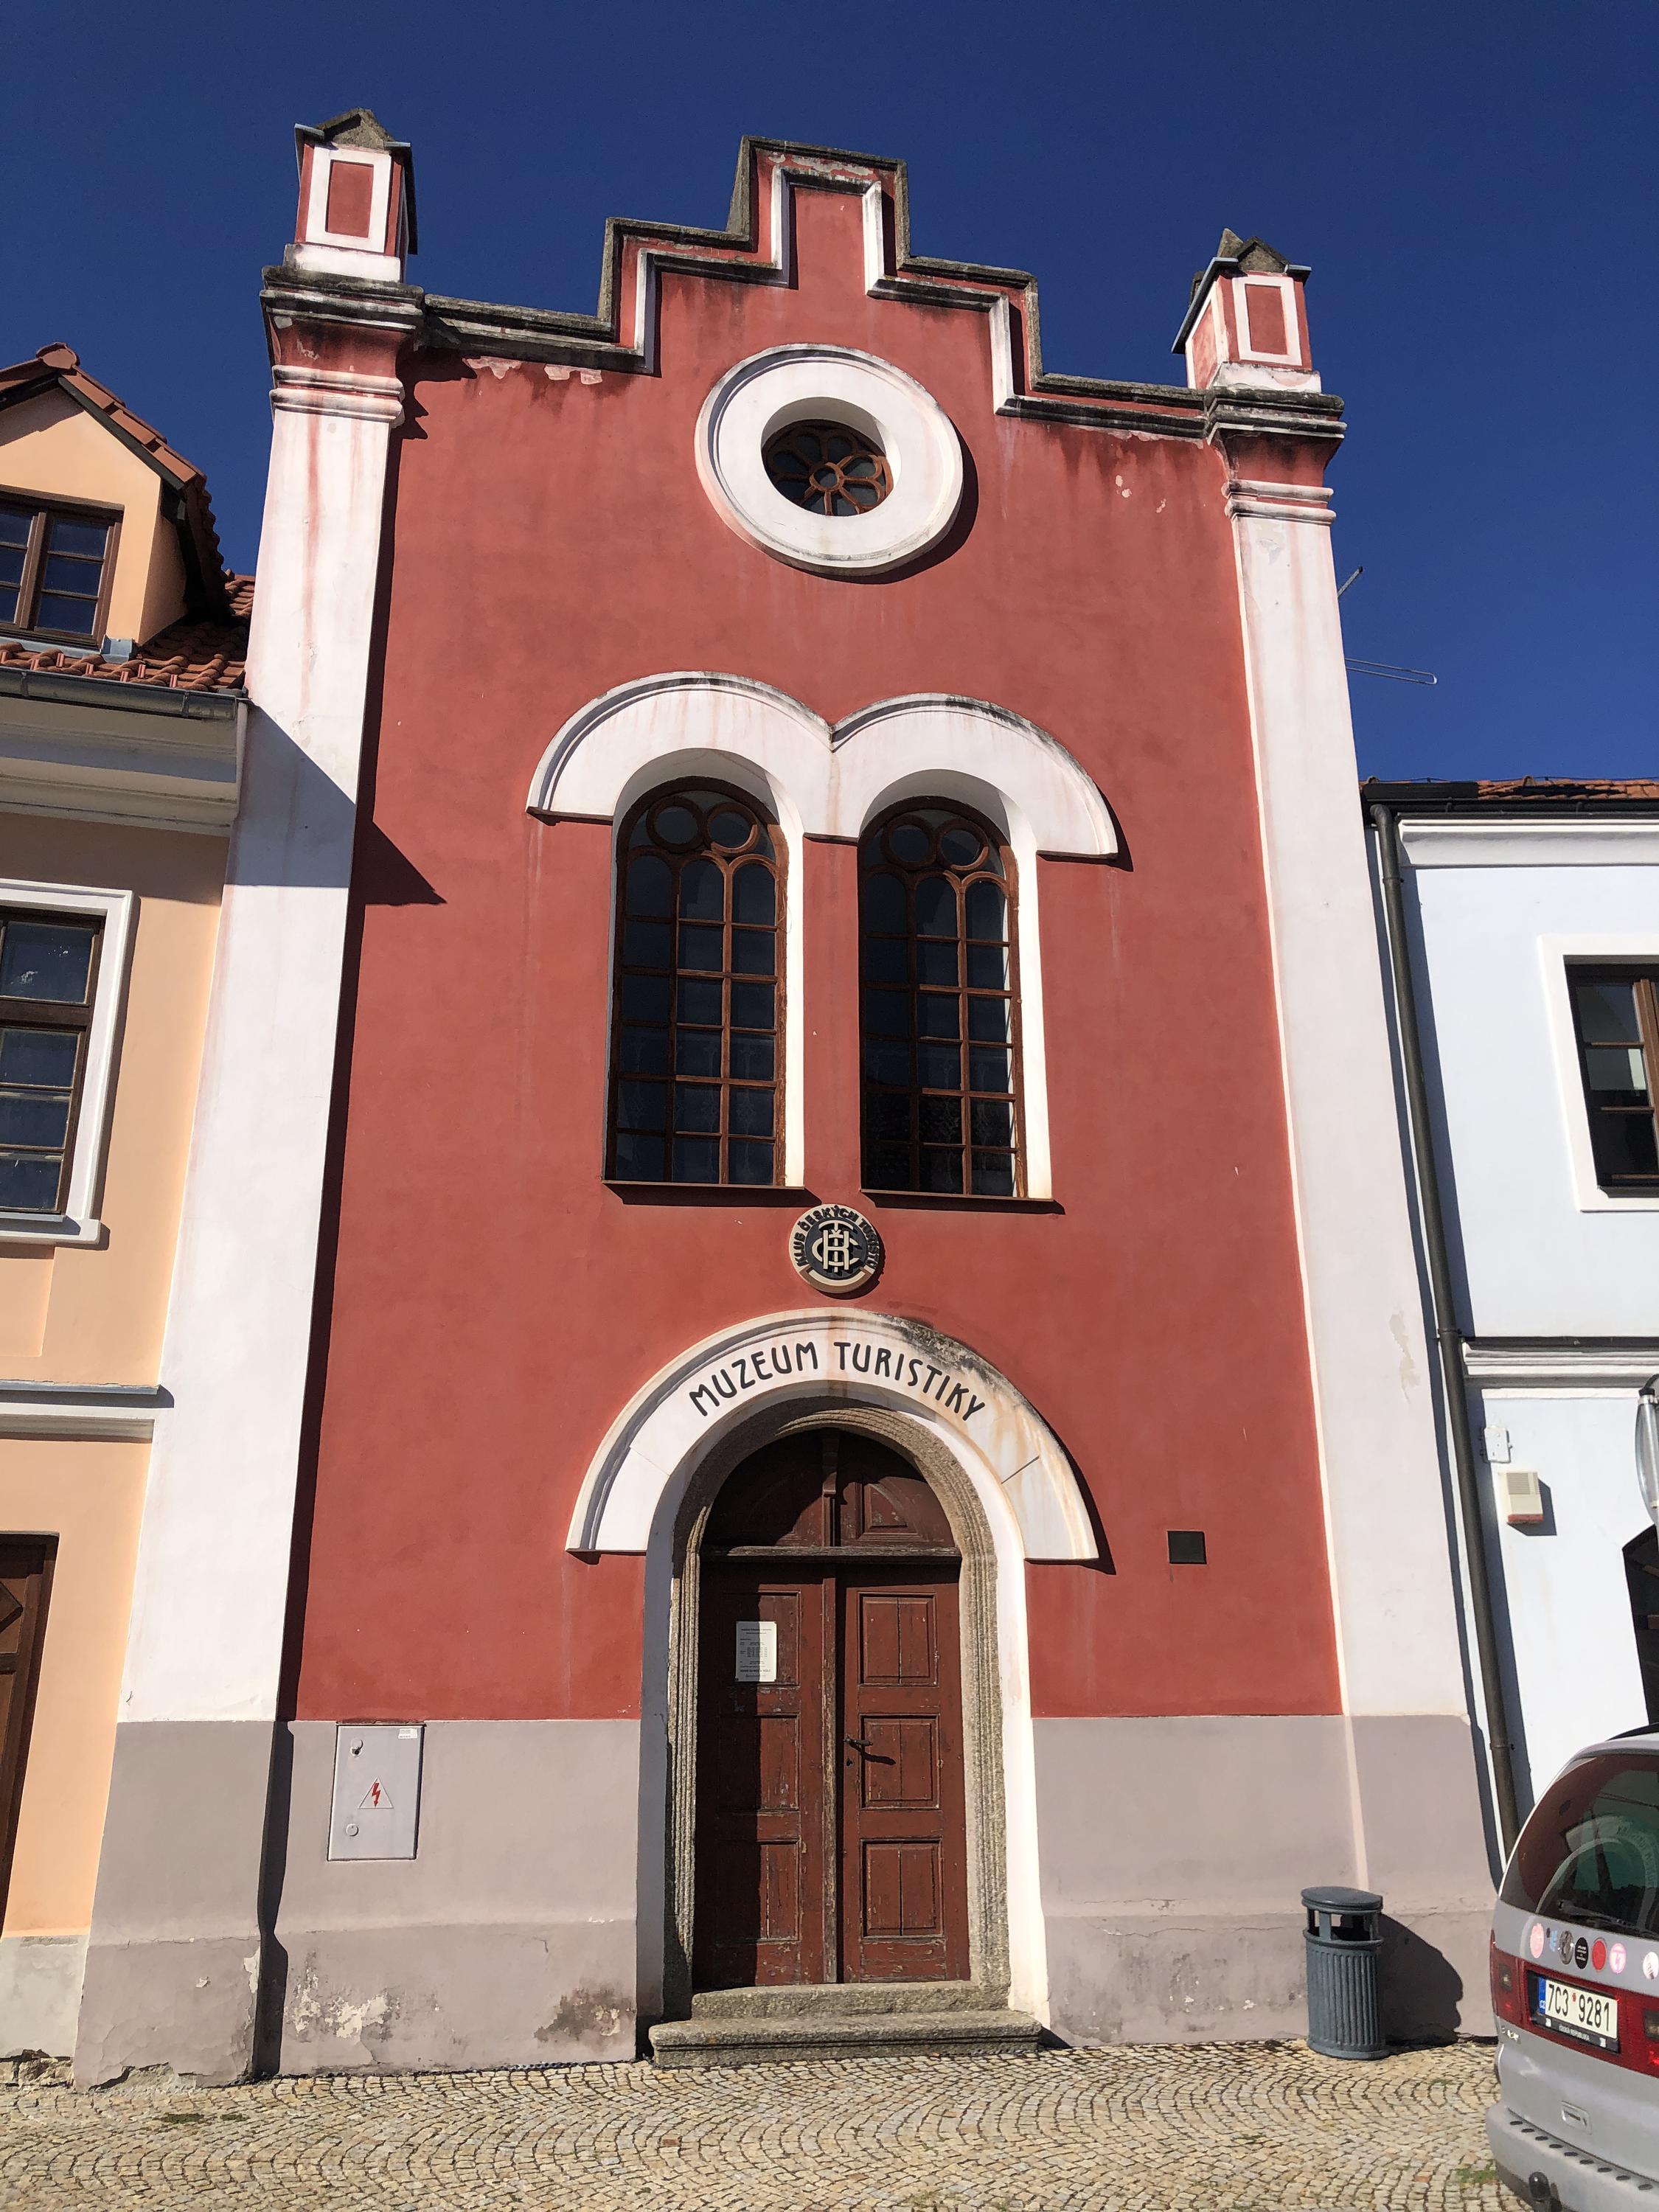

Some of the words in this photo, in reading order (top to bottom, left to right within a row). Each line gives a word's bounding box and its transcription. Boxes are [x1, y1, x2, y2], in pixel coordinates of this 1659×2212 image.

[793, 1232, 810, 1267] KLUB
[689, 1341, 818, 1417] MUZEUM
[833, 1341, 985, 1422] TURISTIKY
[1548, 1983, 1569, 2017] 7C3
[1579, 1994, 1610, 2032] 9281
